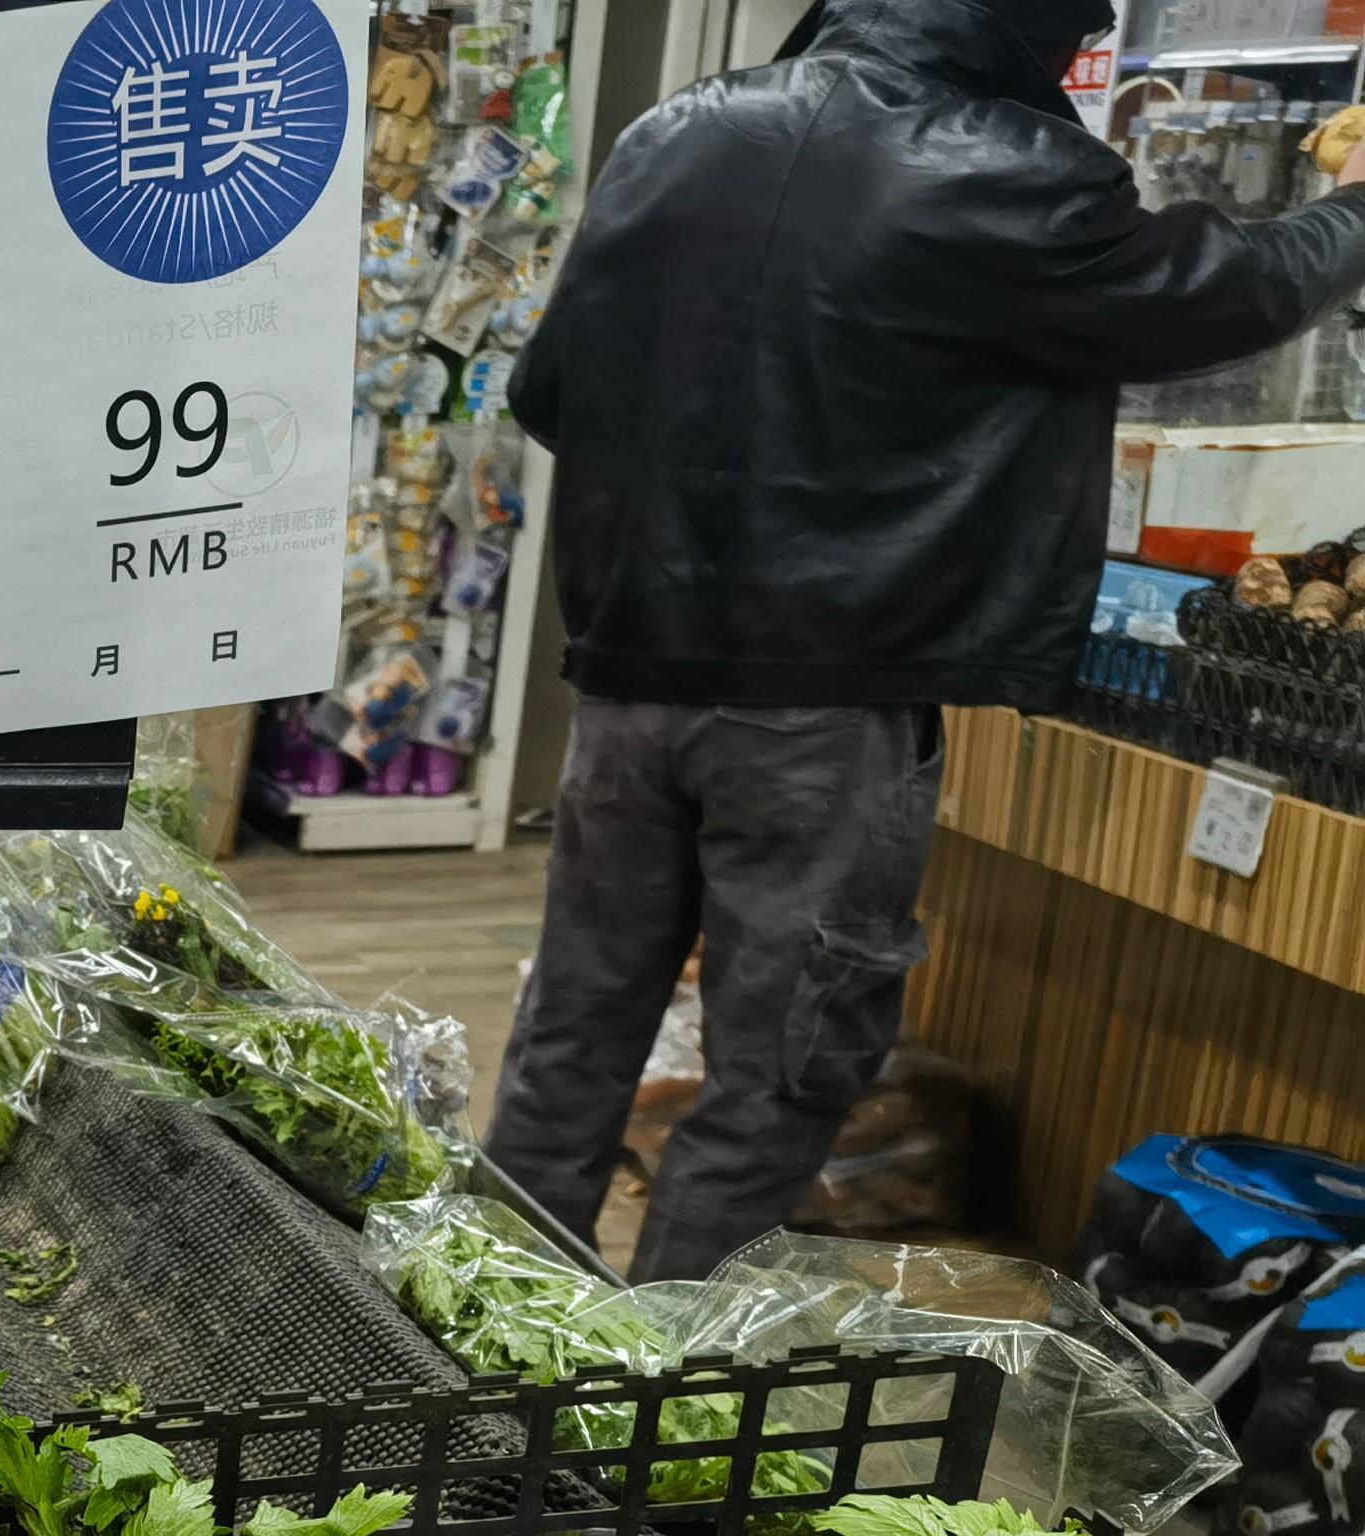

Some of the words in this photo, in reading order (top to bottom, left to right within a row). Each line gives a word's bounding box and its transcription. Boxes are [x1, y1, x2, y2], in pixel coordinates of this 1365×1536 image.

[111, 49, 283, 190] 售卖
[105, 380, 229, 487] 99
[110, 530, 229, 584] RMB
[91, 644, 120, 678] 月
[211, 630, 238, 662] 日
